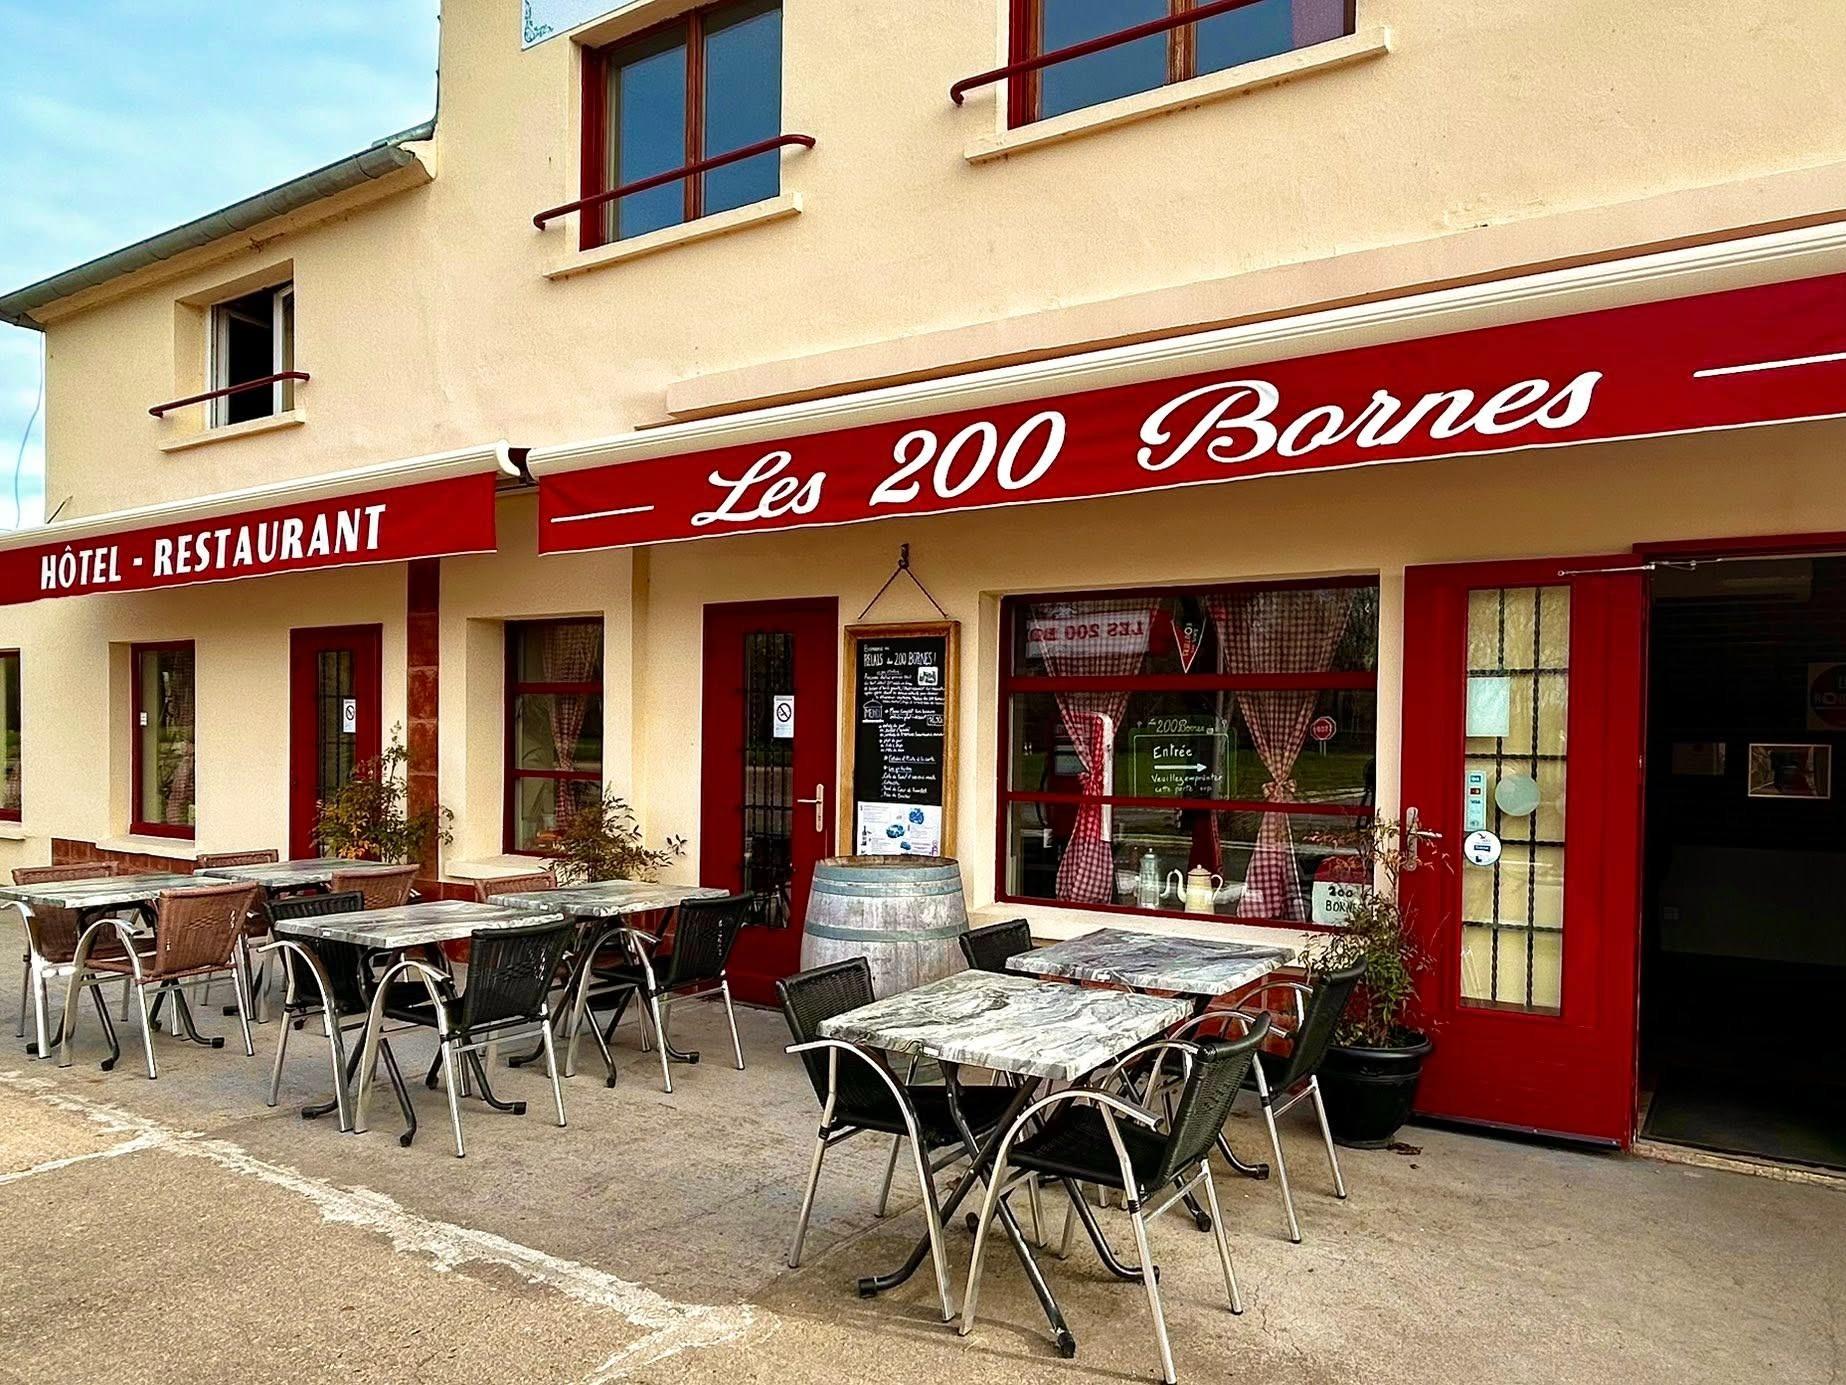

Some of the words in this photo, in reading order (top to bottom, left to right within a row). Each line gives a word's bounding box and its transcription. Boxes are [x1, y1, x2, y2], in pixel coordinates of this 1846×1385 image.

[690, 450, 827, 527] Les
[868, 410, 1067, 507] 200
[1136, 370, 1604, 471] Bornes
[40, 545, 122, 590] HÔTEL
[132, 556, 143, 567] -
[153, 504, 387, 577] RESTAURANT
[894, 652, 908, 666] 200
[1157, 719, 1178, 733] 200
[1153, 744, 1192, 759] Entrée
[1151, 773, 1185, 786] Veuillez
[1328, 886, 1353, 897] 200
